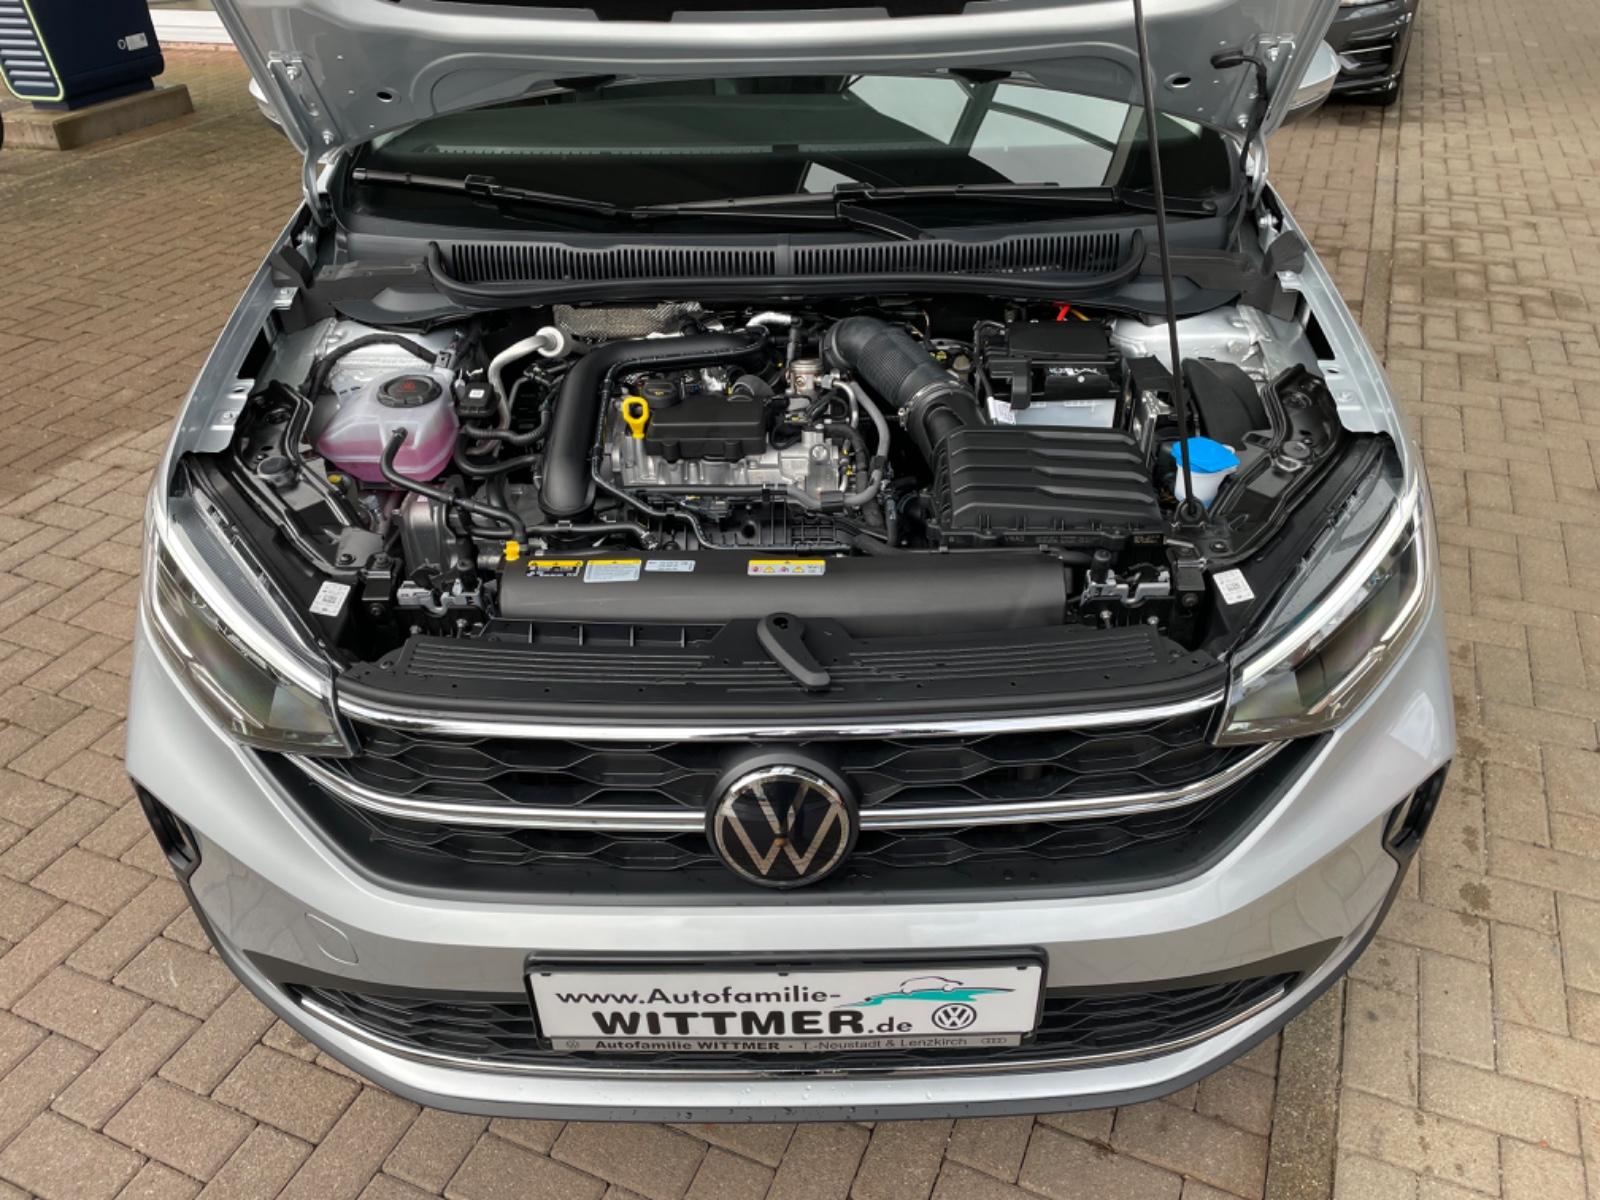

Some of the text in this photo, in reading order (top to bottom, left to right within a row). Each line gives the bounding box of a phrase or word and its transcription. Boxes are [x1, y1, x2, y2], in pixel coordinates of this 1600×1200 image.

[556, 985, 841, 1005] www.Autofamilie-
[595, 1040, 692, 1051] Autofamilie
[696, 1041, 781, 1051] WITTMER
[885, 1040, 895, 1048] &
[900, 1037, 968, 1048] Lenzkirch
